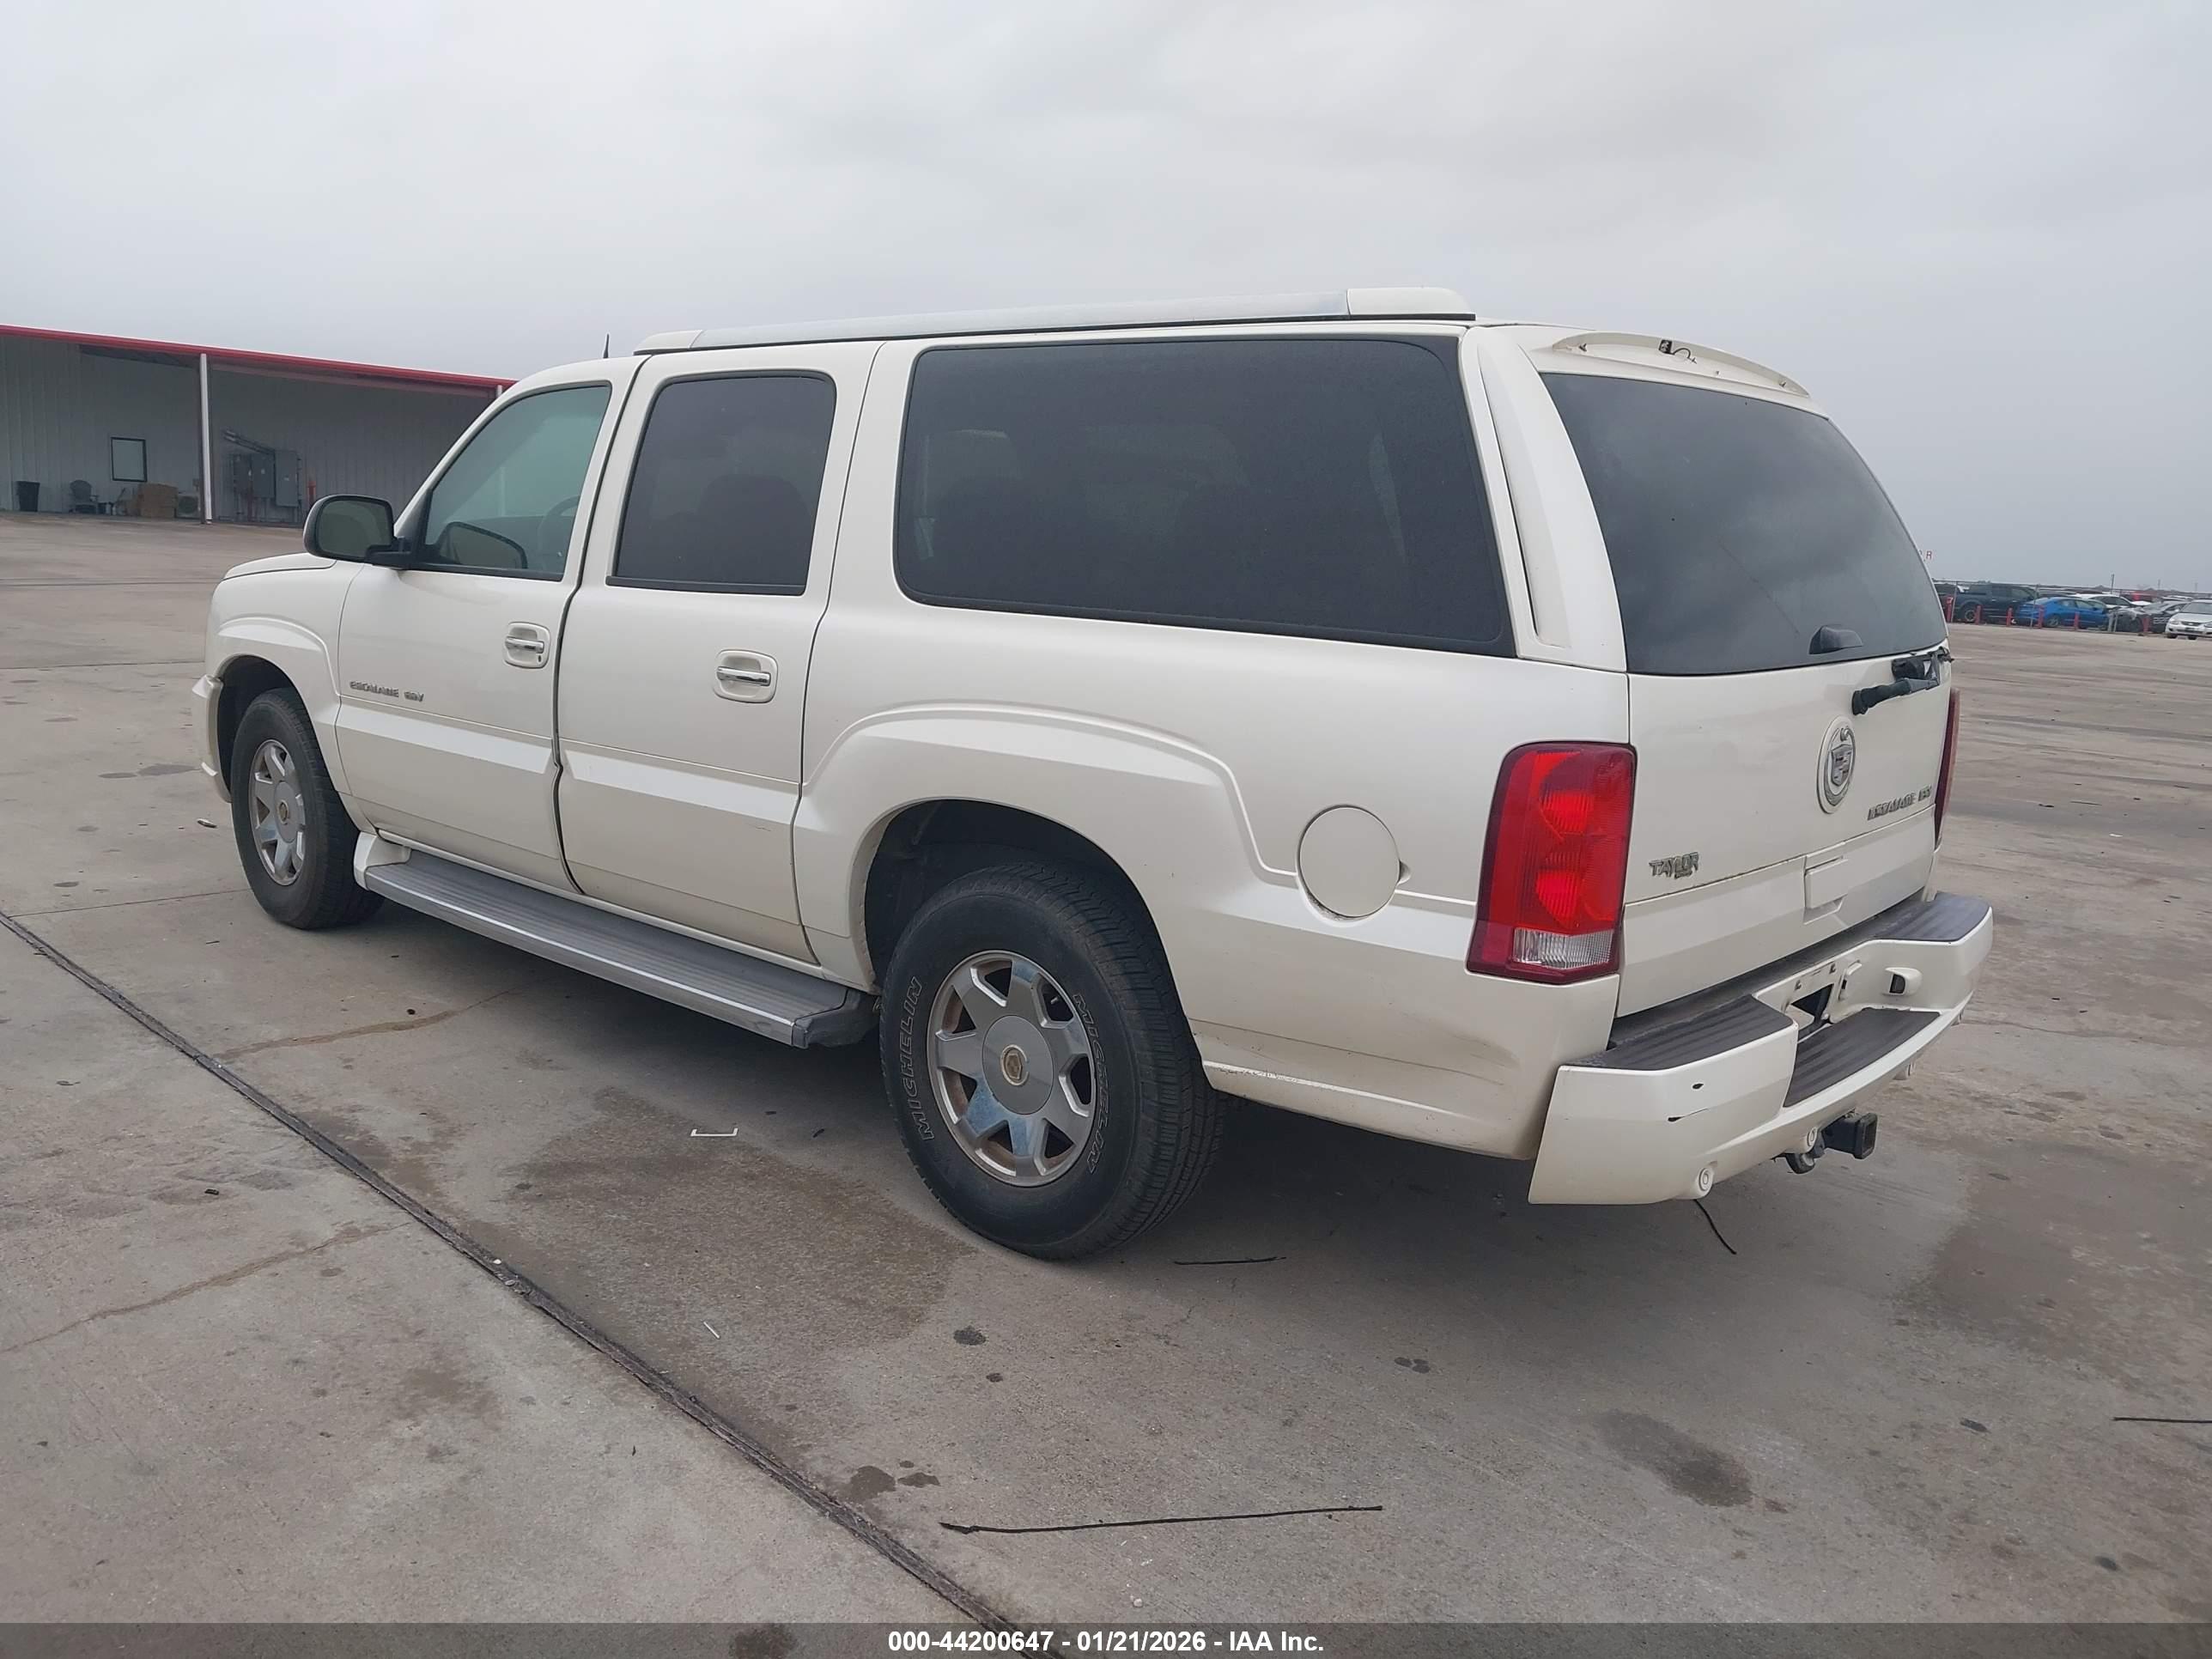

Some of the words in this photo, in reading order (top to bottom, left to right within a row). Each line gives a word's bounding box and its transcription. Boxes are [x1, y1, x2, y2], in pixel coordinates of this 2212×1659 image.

[1649, 852, 1698, 877] TAYLOR
[899, 976, 935, 1140] MICHELIN
[1073, 994, 1109, 1174] MICHELIN
